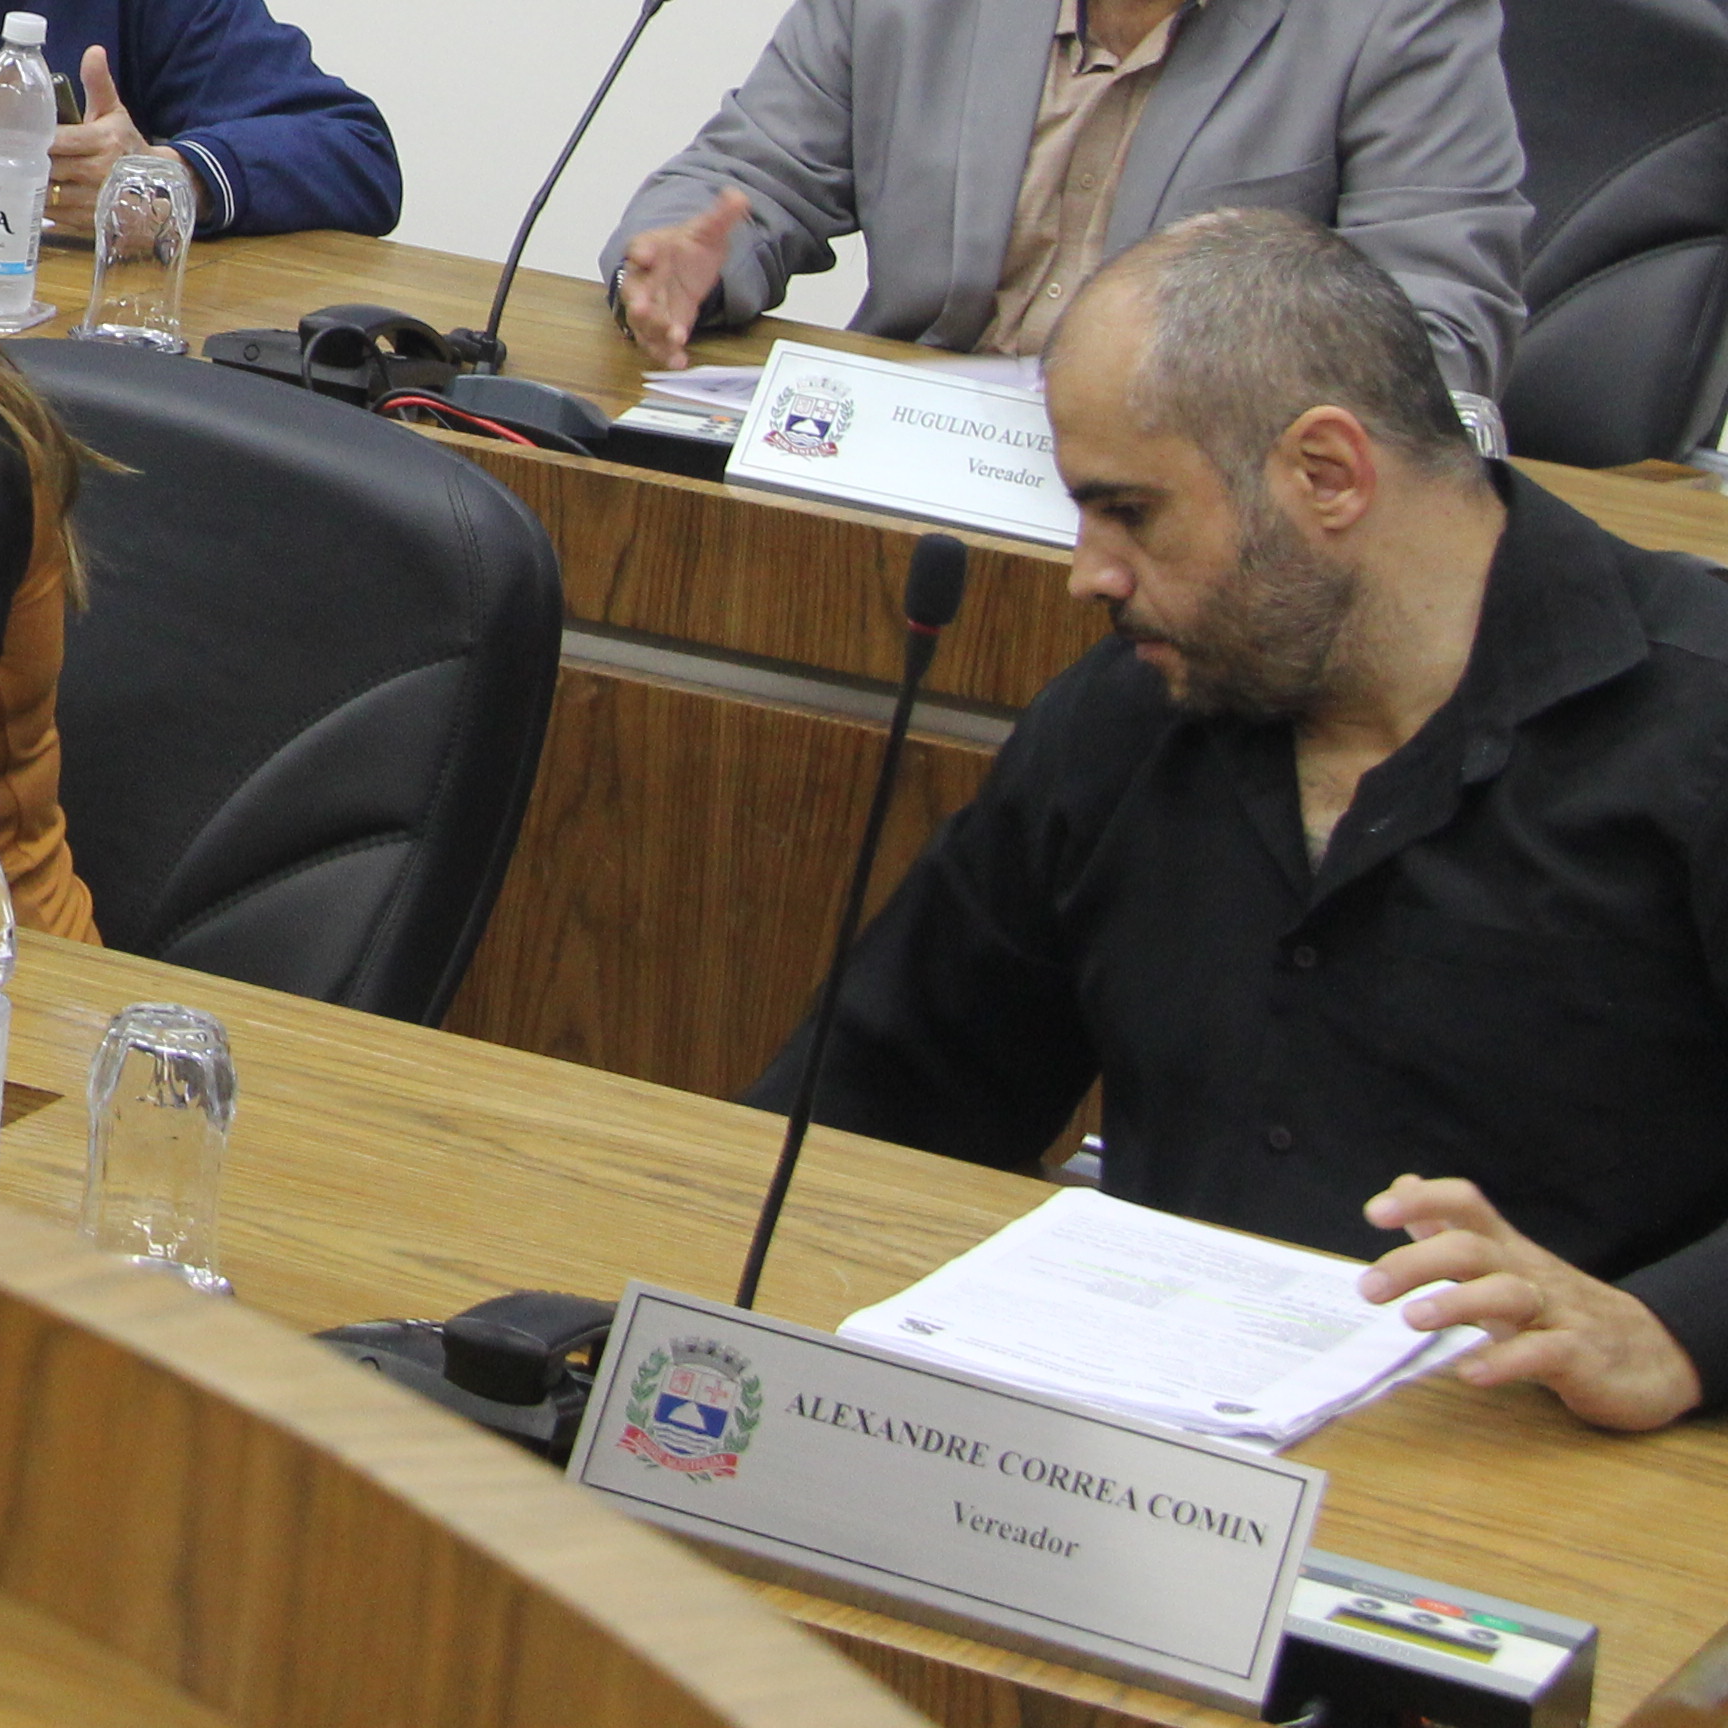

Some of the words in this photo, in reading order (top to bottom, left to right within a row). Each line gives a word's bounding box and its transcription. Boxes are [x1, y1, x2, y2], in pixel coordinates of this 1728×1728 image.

[892, 405, 996, 440] HUGULINO
[998, 429, 1055, 453] ALVE
[968, 457, 1046, 488] Vereador
[785, 1392, 989, 1468] ALEXANDRE
[998, 1450, 1137, 1512] CORREA
[1147, 1492, 1269, 1547] COMIN
[953, 1500, 1080, 1558] Vereador
